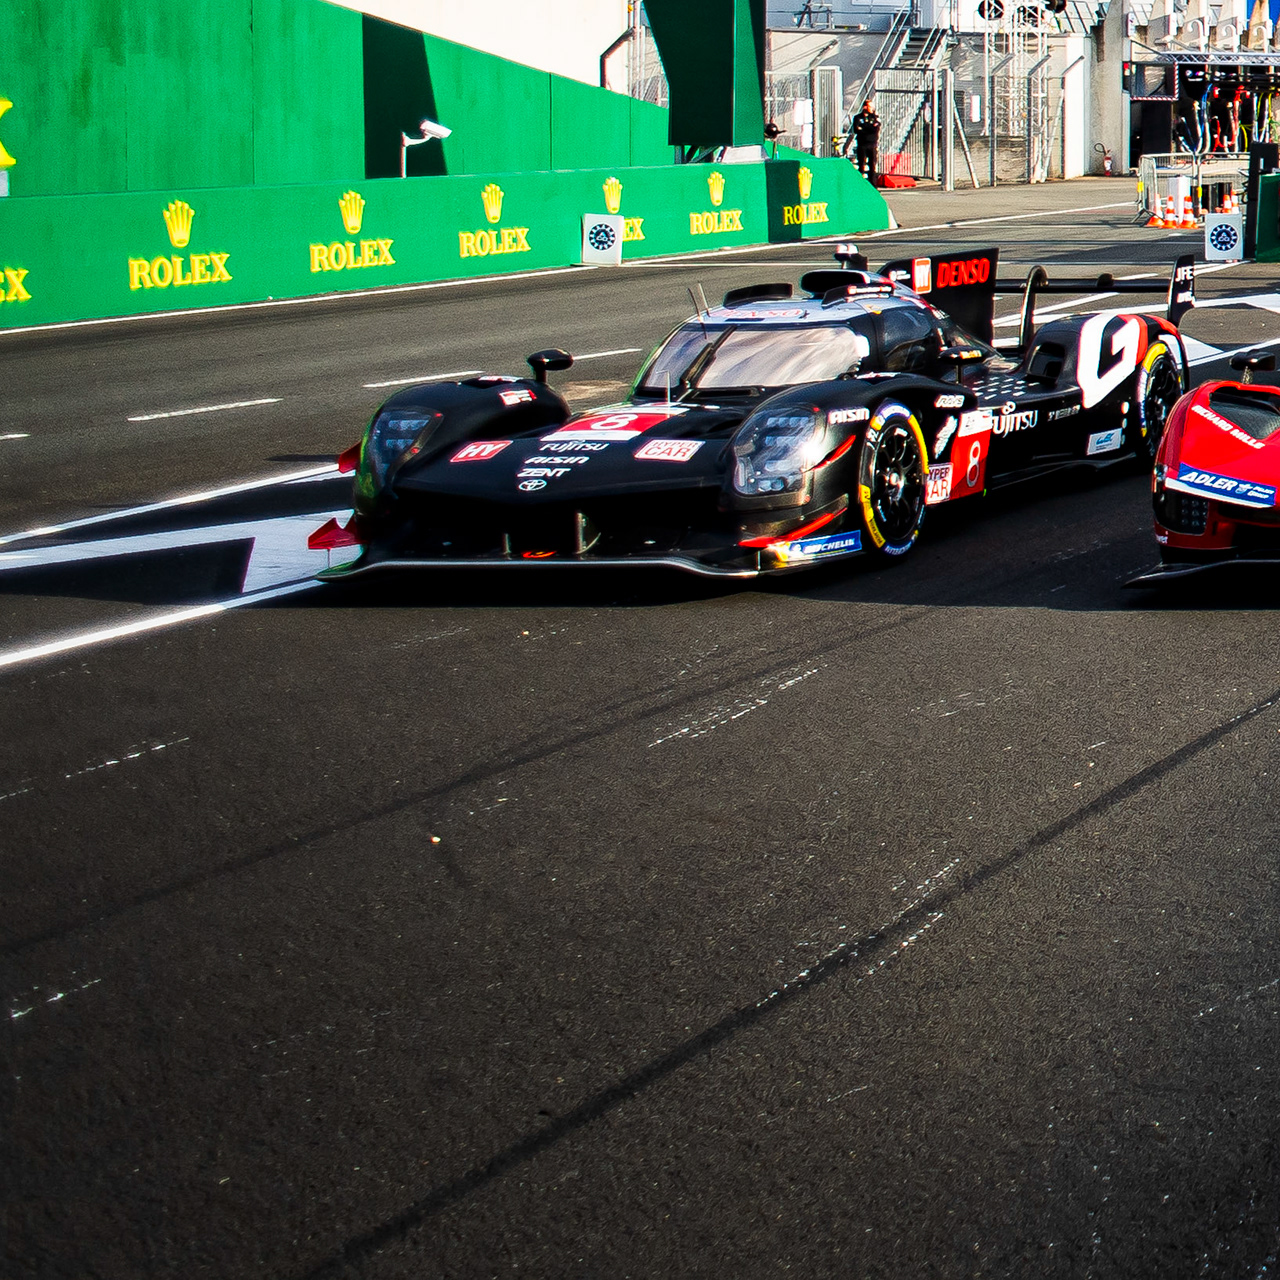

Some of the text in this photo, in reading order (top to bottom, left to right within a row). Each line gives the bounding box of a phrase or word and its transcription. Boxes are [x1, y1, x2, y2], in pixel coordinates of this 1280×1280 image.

[690, 210, 743, 235] ROLEX
[783, 202, 829, 226] ROLEX
[458, 226, 531, 258] ROLEX
[309, 238, 396, 273] ROLEX
[128, 252, 233, 291] ROLEX
[937, 258, 990, 288] DENSO
[591, 414, 638, 430] 8
[992, 410, 1038, 438] UJITSU
[1191, 405, 1265, 449] RICHARD MILLE
[458, 443, 504, 459] HY
[540, 443, 609, 453] FUJITSU
[643, 447, 691, 460] CAR
[650, 439, 699, 448] HYPER
[524, 456, 590, 464] AISIN
[966, 440, 982, 488] 8
[517, 468, 571, 477] ZENT
[927, 467, 950, 480] YPER
[1179, 471, 1238, 491] ADLER
